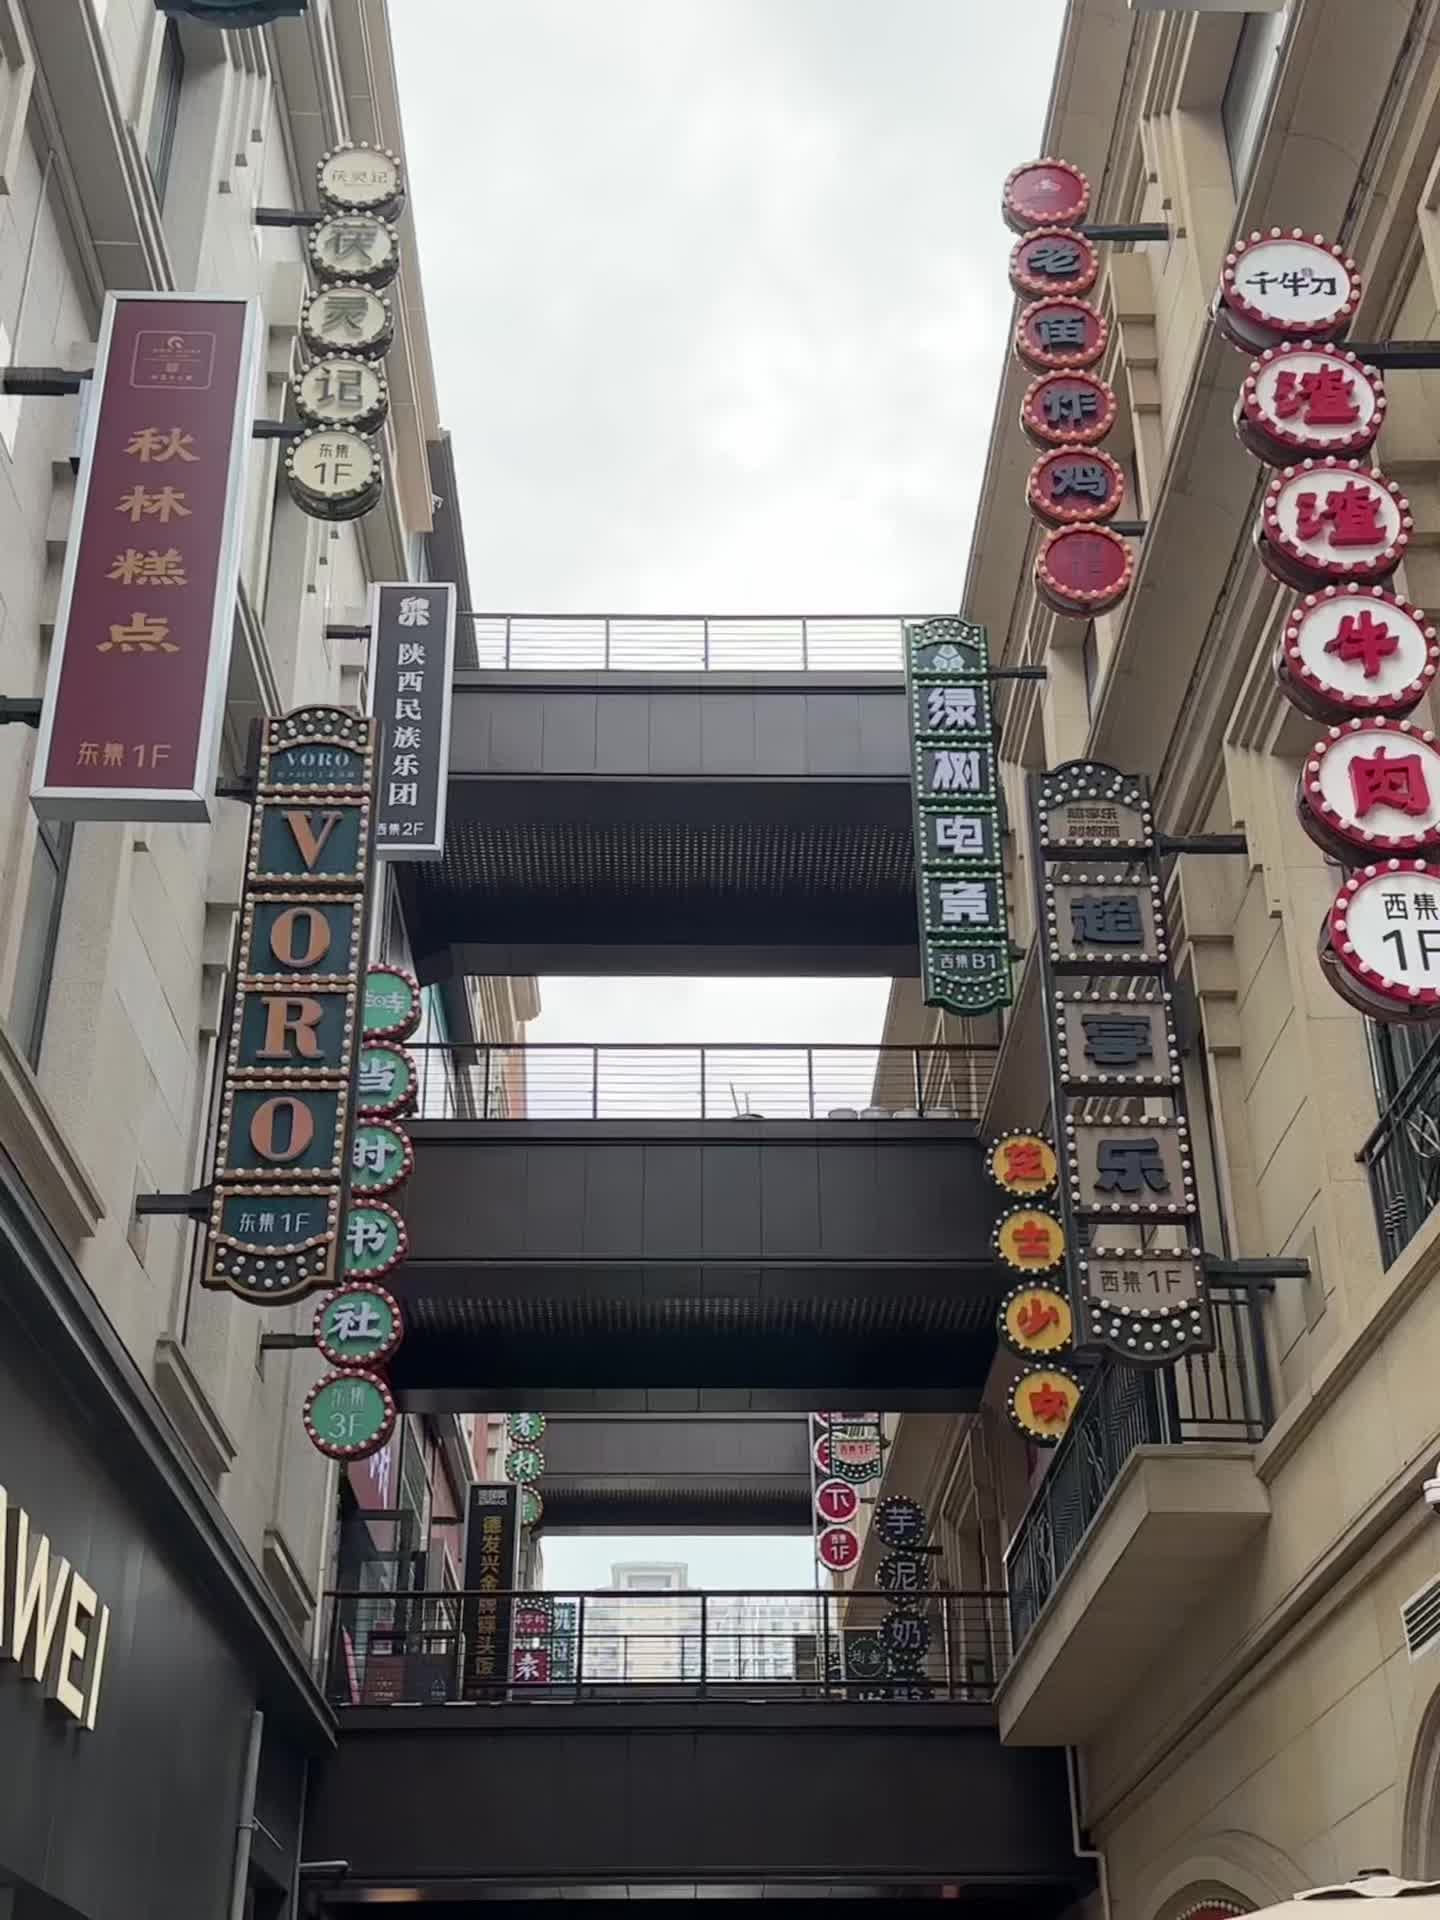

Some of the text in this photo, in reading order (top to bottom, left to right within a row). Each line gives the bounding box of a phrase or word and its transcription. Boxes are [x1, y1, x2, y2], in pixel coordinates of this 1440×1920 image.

[1244, 271, 1337, 297] 千牛刀
[316, 223, 378, 405] 茯灵记
[319, 442, 352, 456] 东集
[314, 463, 352, 485] 1F
[97, 427, 201, 653] 秋林糕点
[388, 643, 427, 807] 陕西民族乐团
[76, 741, 172, 768] 东集 1F
[286, 752, 351, 767] VORO
[402, 823, 425, 836] 2F
[1381, 893, 1440, 920] 西集
[940, 954, 997, 970] 西集 B1
[1382, 929, 1440, 971] 1F
[250, 810, 343, 1162] VORO
[239, 1213, 311, 1233] 东集 1F
[1100, 1271, 1183, 1294] 西集 1F
[328, 1412, 365, 1438] 3F
[0, 1483, 110, 1731] WEI
